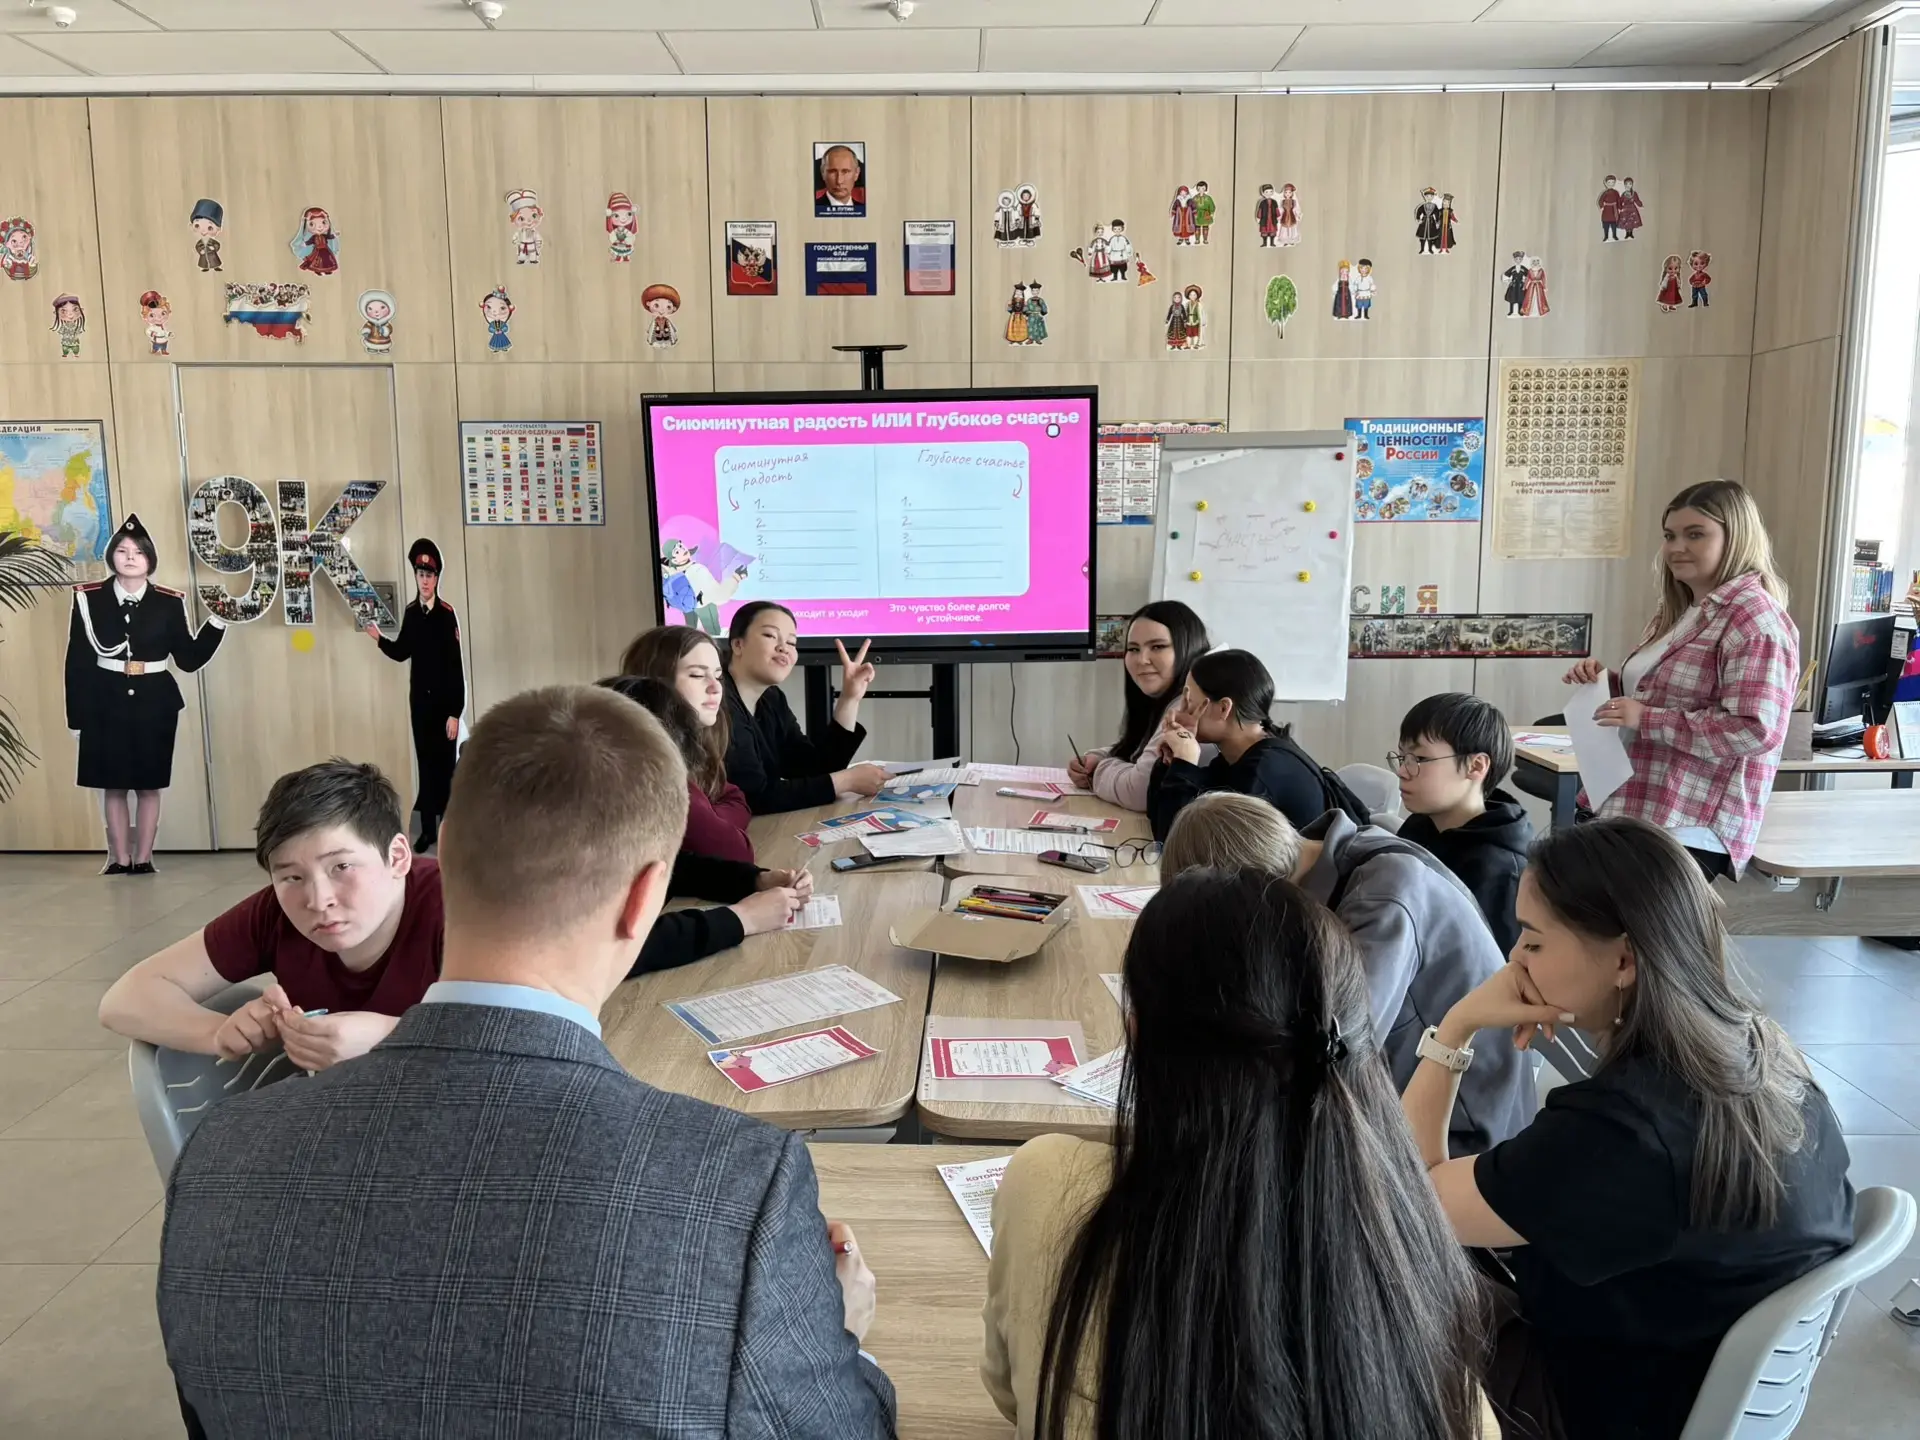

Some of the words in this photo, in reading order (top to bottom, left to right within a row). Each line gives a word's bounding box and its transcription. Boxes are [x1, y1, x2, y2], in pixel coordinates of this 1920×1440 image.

[662, 415, 790, 434] Сиюминутная
[793, 415, 868, 432] радость
[872, 412, 912, 428] ИЛИ
[916, 411, 1003, 430] Глубокое
[1006, 411, 1080, 426] счастье
[1182, 424, 1211, 433] России
[0, 425, 41, 434] ДЕРАЦИЯ
[1376, 435, 1448, 447] ЦЕННОСТИ
[721, 452, 809, 474] Сиюминутная
[917, 449, 972, 467] Глубокое
[975, 457, 1026, 469] счастье
[743, 472, 793, 490] радость
[754, 498, 765, 510] 1.
[756, 517, 767, 529] 2.
[757, 534, 767, 546] 3.
[758, 553, 768, 564] 4.
[759, 568, 769, 580] 5.
[1350, 584, 1439, 615] СИЯ
[793, 609, 826, 620] иходит
[828, 610, 835, 618] и
[836, 608, 869, 619] уходит
[889, 603, 907, 612] Это
[908, 604, 946, 614] чувство
[947, 602, 976, 612] более
[977, 602, 1011, 612] долгое
[917, 615, 924, 623] и
[925, 613, 984, 625] устойчивое.
[965, 1171, 1005, 1182] КОТОРЫ
